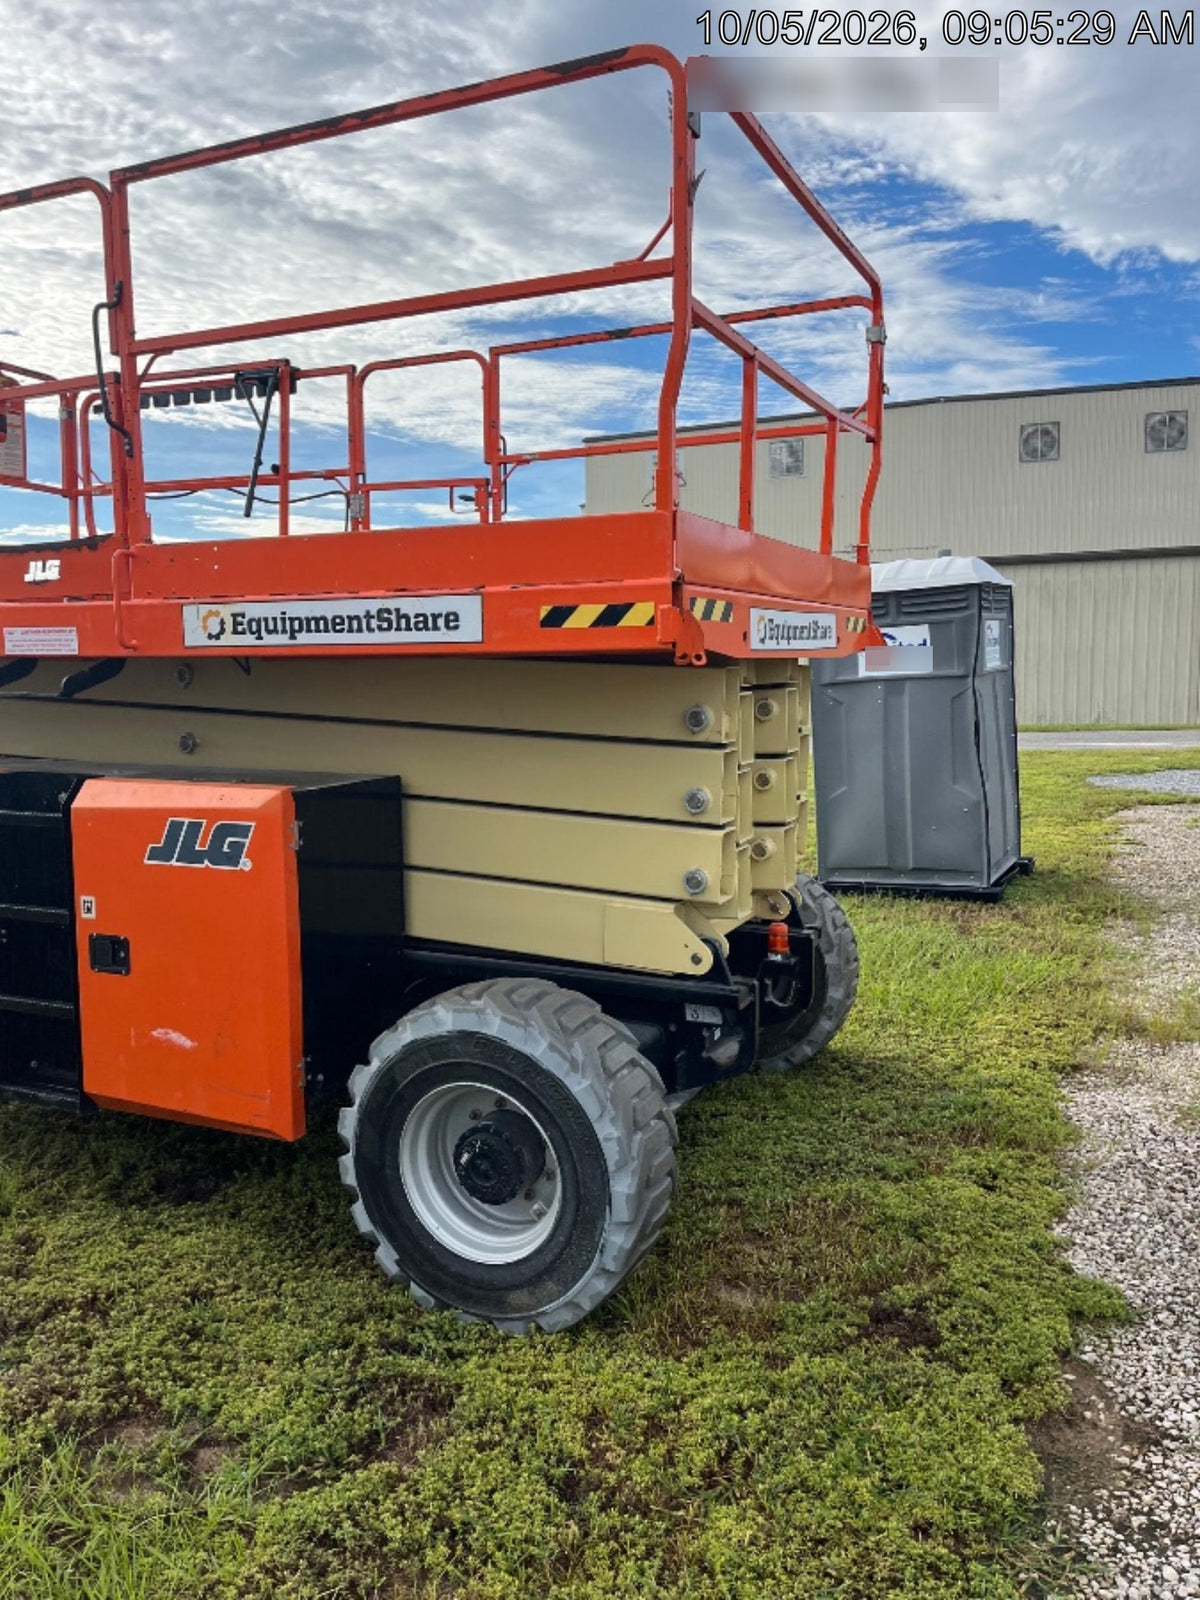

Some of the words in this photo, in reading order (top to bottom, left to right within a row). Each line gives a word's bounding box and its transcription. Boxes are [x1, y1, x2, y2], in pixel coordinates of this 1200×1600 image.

[24, 559, 61, 582] JLG
[230, 607, 460, 640] EquipmentShare
[768, 618, 833, 646] EquipmentShare
[144, 817, 256, 870] JLG
